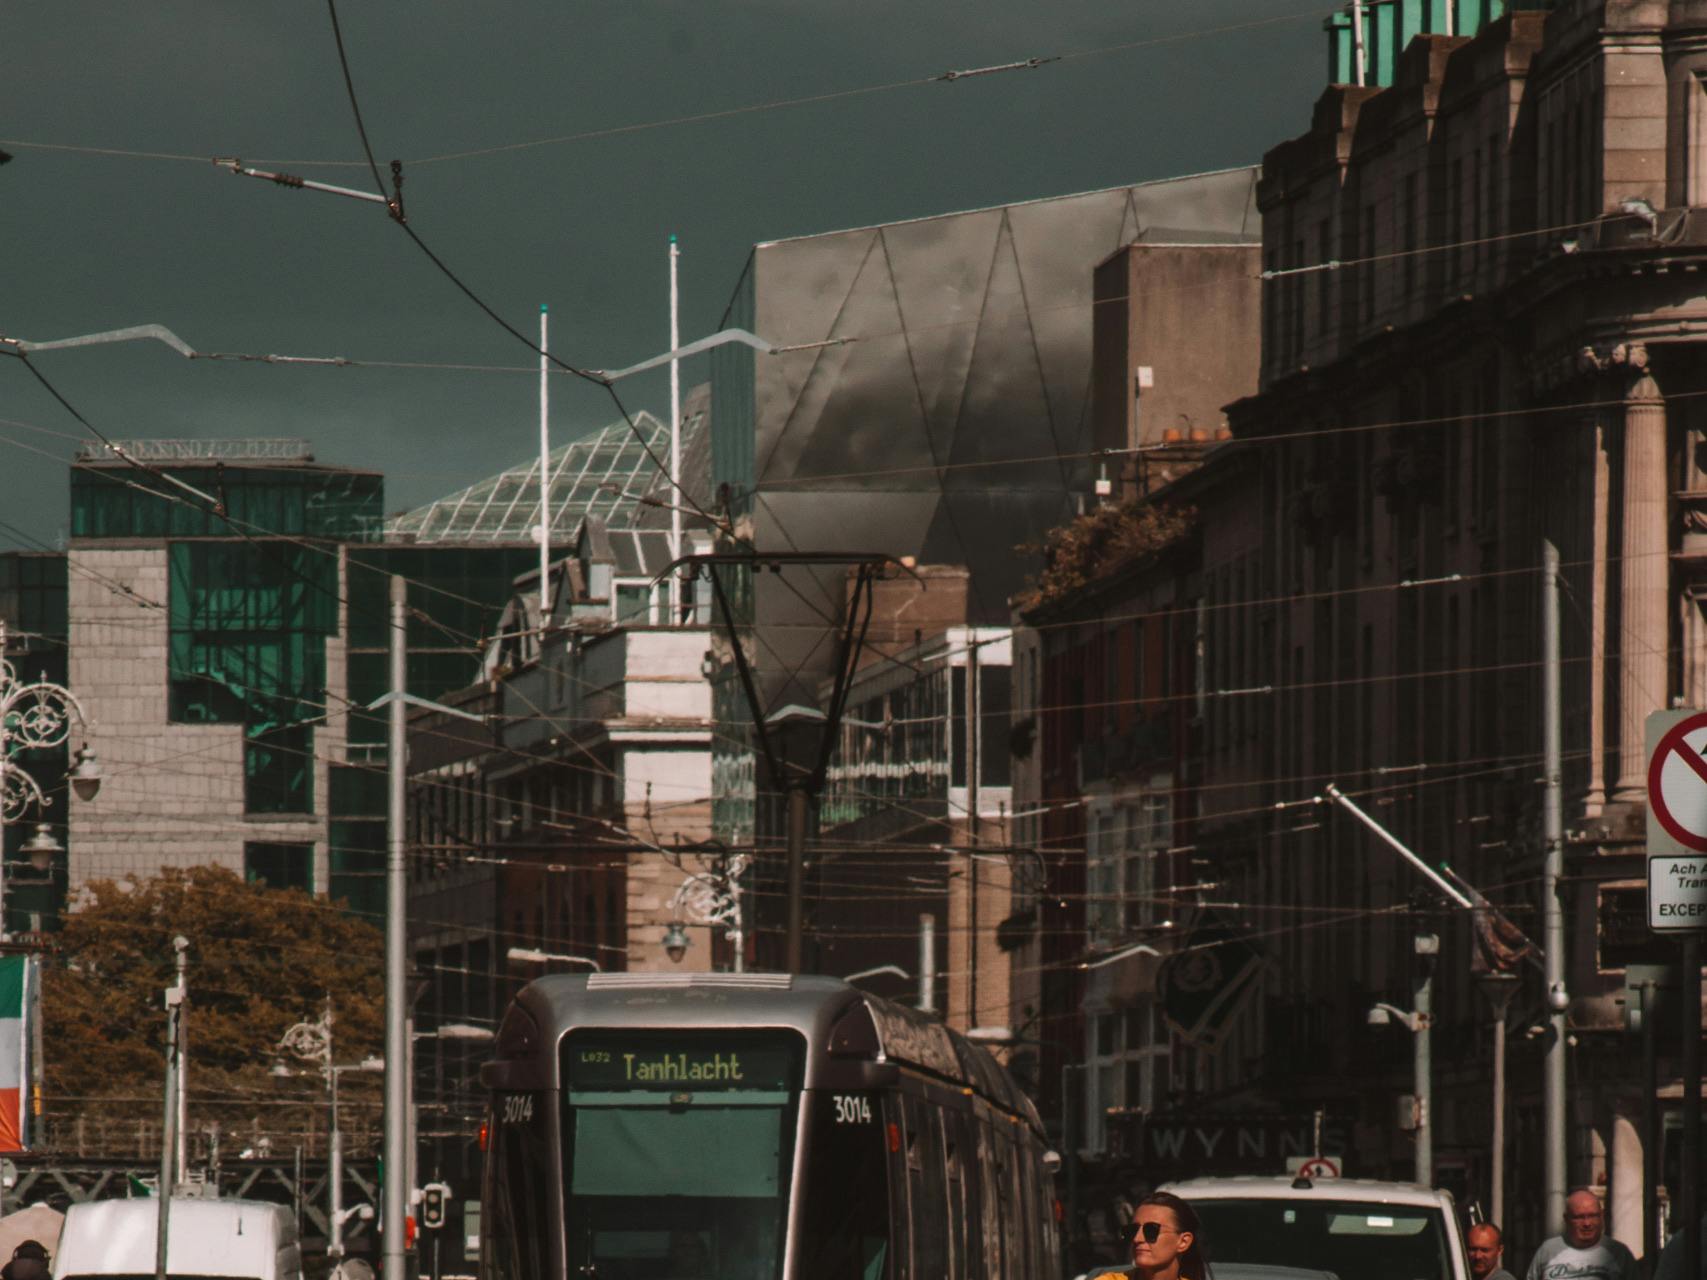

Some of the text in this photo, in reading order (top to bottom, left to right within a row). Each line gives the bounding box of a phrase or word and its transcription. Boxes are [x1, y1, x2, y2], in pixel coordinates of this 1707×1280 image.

[1670, 864, 1697, 874] Ach
[502, 1094, 534, 1124] 3014
[832, 1095, 873, 1124] 3014
[1150, 1126, 1347, 1158] WYNNS
